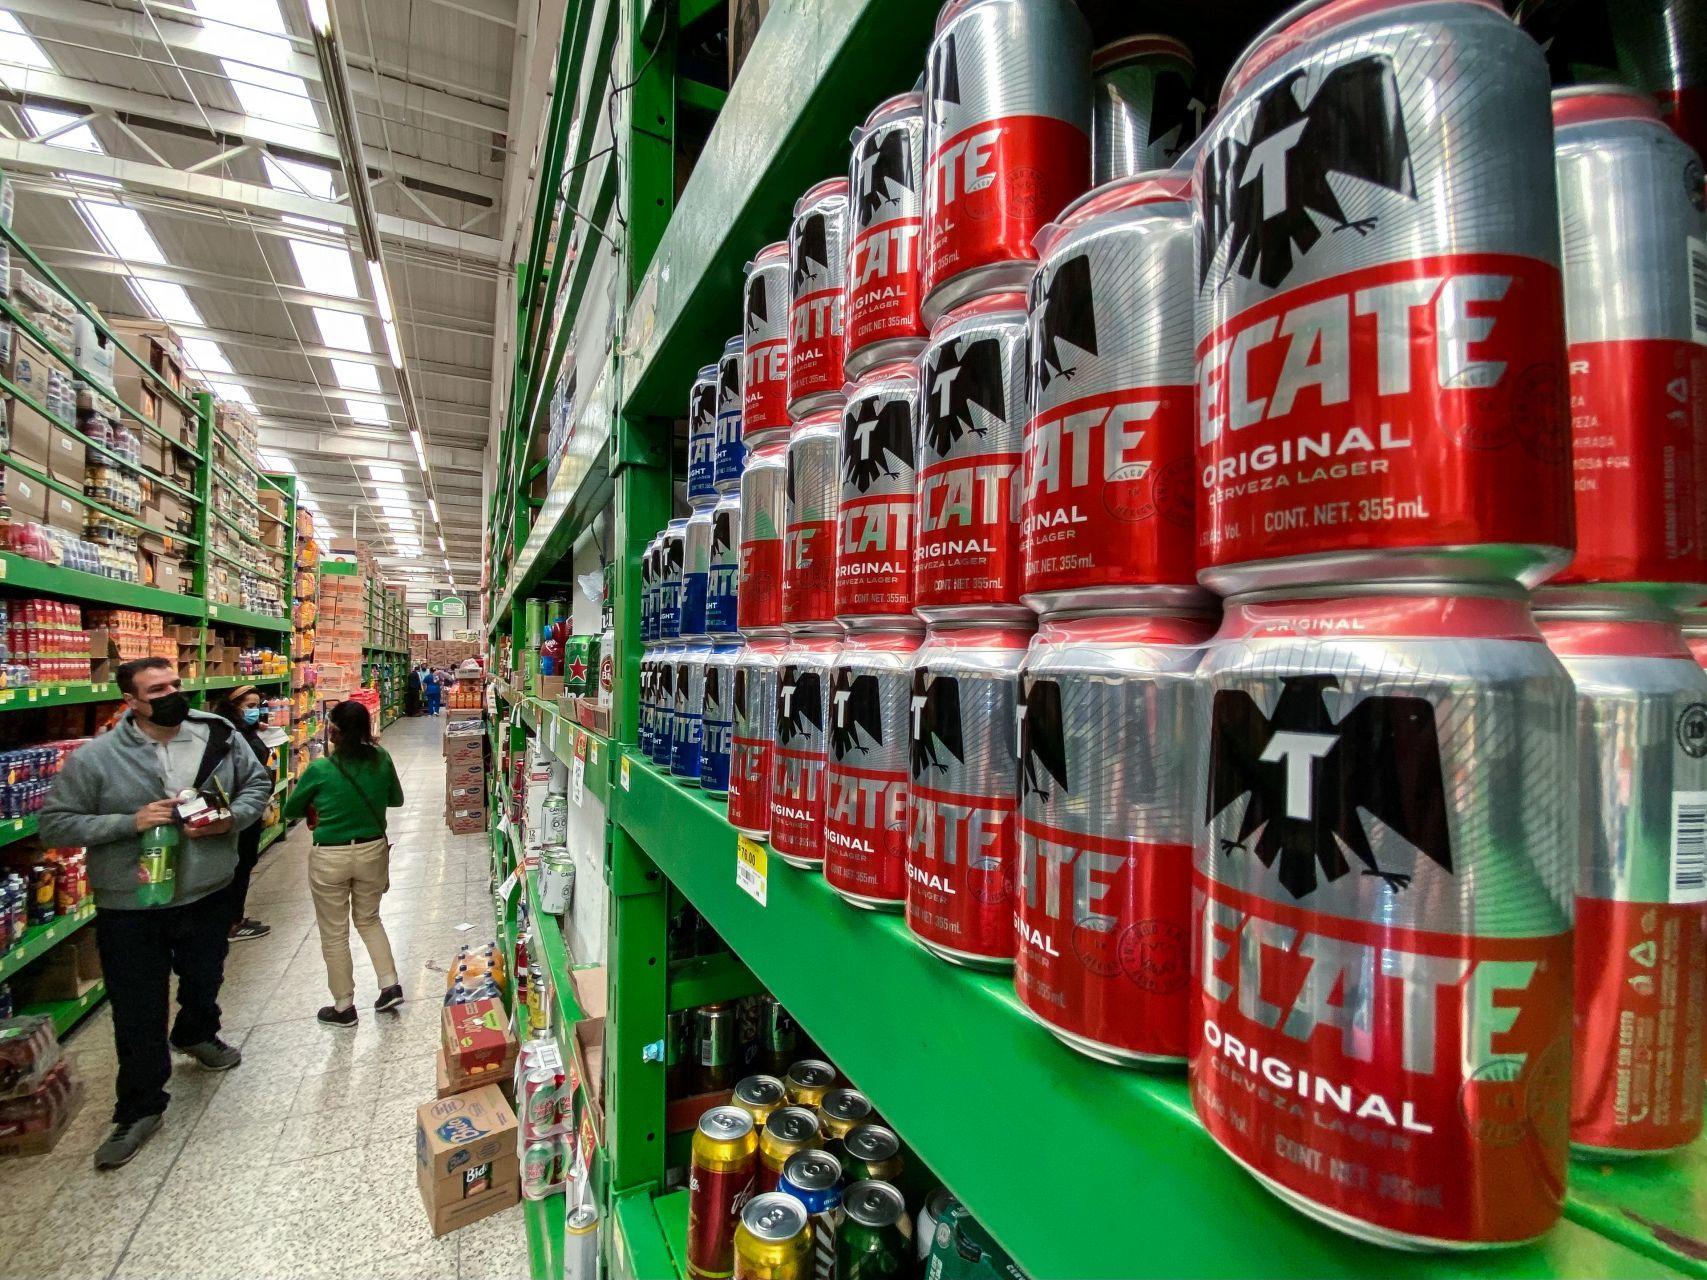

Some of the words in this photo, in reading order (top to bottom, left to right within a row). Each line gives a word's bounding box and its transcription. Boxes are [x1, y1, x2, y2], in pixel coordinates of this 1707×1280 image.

[1240, 117, 1310, 221] T
[1197, 273, 1513, 448] ECATE
[931, 366, 962, 418] T
[853, 420, 879, 460] T
[1202, 423, 1412, 489] ORIGINAL
[1298, 459, 1389, 484] LAGER
[1036, 529, 1076, 546] LAGER
[1264, 507, 1309, 532] CONT.
[1314, 501, 1352, 527] NET.
[781, 686, 796, 717] T
[834, 691, 851, 728] T
[910, 696, 927, 740] T
[1258, 731, 1342, 821] T
[1200, 898, 1538, 1083] ECATE
[1204, 1020, 1433, 1134] ORIGINAL
